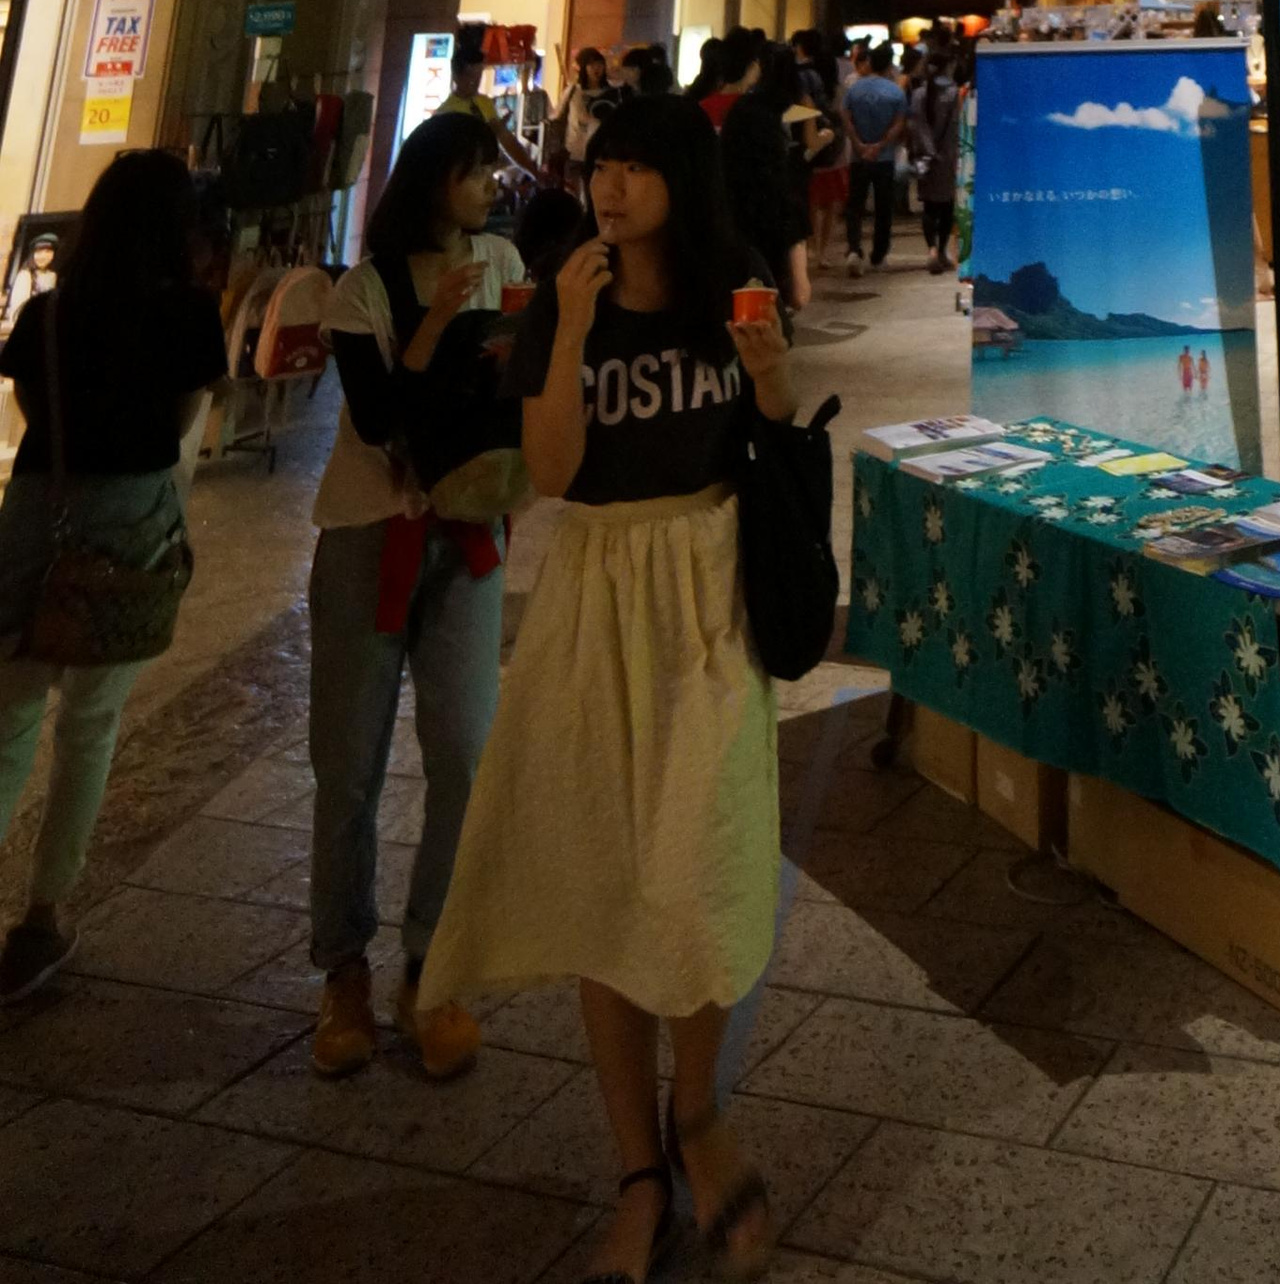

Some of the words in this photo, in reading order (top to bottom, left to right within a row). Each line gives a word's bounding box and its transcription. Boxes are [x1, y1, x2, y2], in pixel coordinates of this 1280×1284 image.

[105, 17, 141, 35] TAX
[96, 36, 140, 54] FREE
[88, 108, 110, 125] 20
